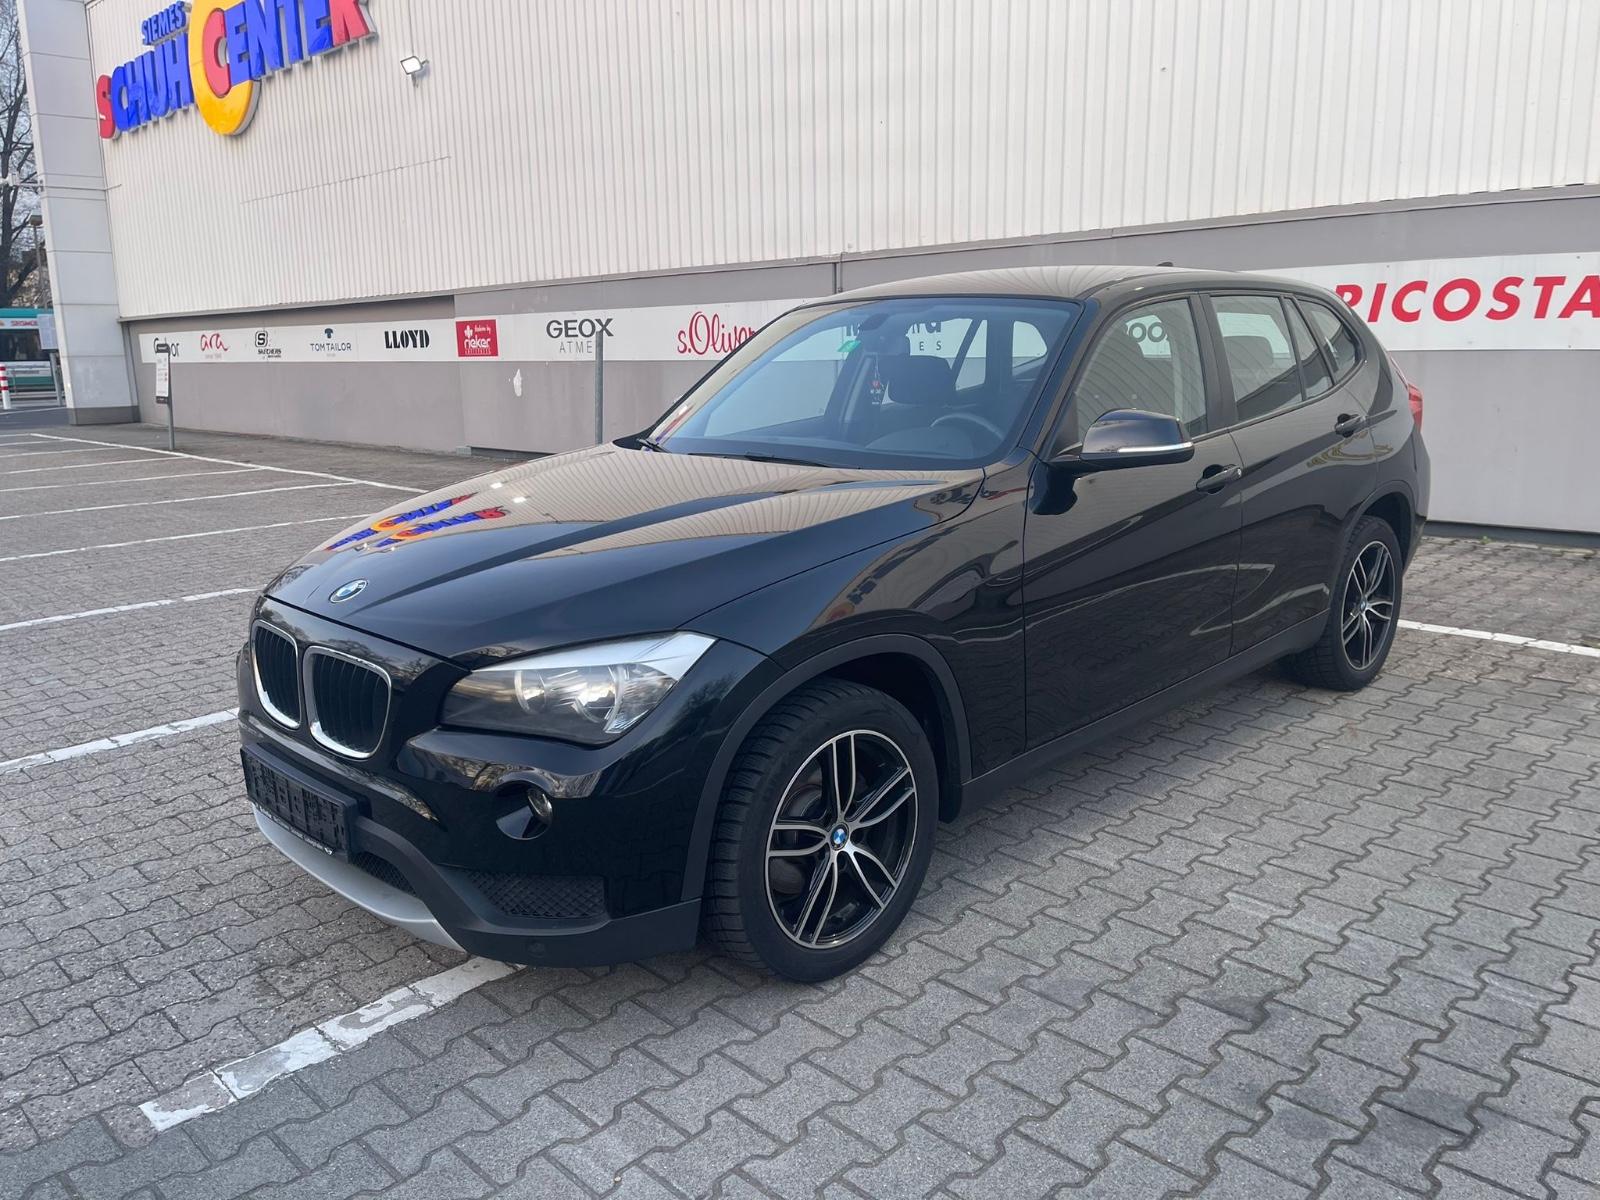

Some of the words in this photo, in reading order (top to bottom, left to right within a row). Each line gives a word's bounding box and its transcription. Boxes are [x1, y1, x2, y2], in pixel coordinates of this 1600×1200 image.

[141, 1, 187, 45] SIEMES
[546, 318, 614, 338] GEOX
[200, 333, 229, 351] ara
[310, 343, 325, 352] TOM
[326, 342, 352, 352] TAILOR
[384, 329, 430, 349] LLOYD
